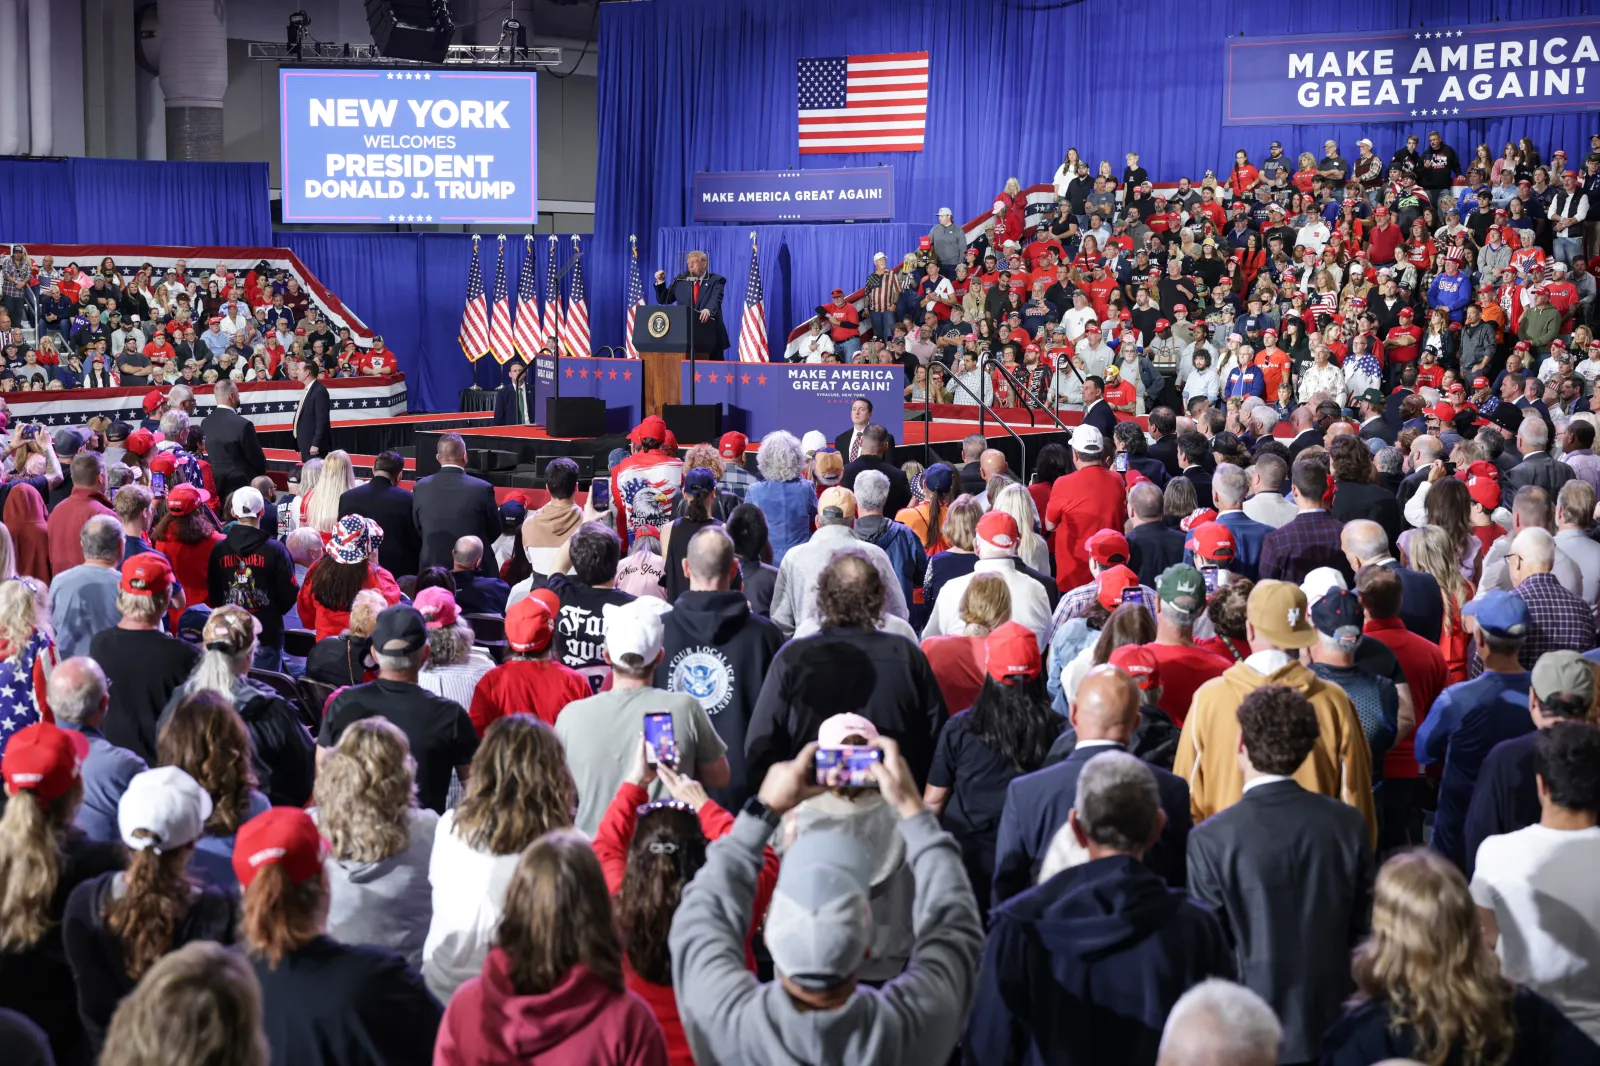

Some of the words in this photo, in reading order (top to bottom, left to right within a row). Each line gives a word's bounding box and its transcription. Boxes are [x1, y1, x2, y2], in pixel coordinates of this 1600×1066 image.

[1288, 48, 1394, 79] MAKE
[1409, 35, 1600, 75] AMERICA
[1297, 78, 1423, 108] GREAT
[1437, 67, 1586, 104] AGAIN!
[309, 98, 398, 127] NEW
[407, 99, 511, 129] YORK
[363, 134, 457, 149] WELCOMES
[326, 153, 494, 178] PRESIDENT
[305, 180, 406, 199] DONALD
[410, 181, 429, 199] J.
[434, 181, 516, 200] TRUMP
[702, 192, 735, 203] MAKE
[738, 191, 791, 202] AMERICA
[794, 190, 835, 201] GREAT
[838, 188, 883, 200] AGAIN!
[788, 369, 827, 379] MAKE
[831, 369, 894, 380] AMERICA
[792, 381, 837, 390] GREAT
[841, 381, 890, 391] AGAIN!
[640, 563, 662, 579] York
[669, 647, 693, 668] YOUR
[696, 645, 728, 665] LOCAL
[725, 664, 736, 683] ICE
